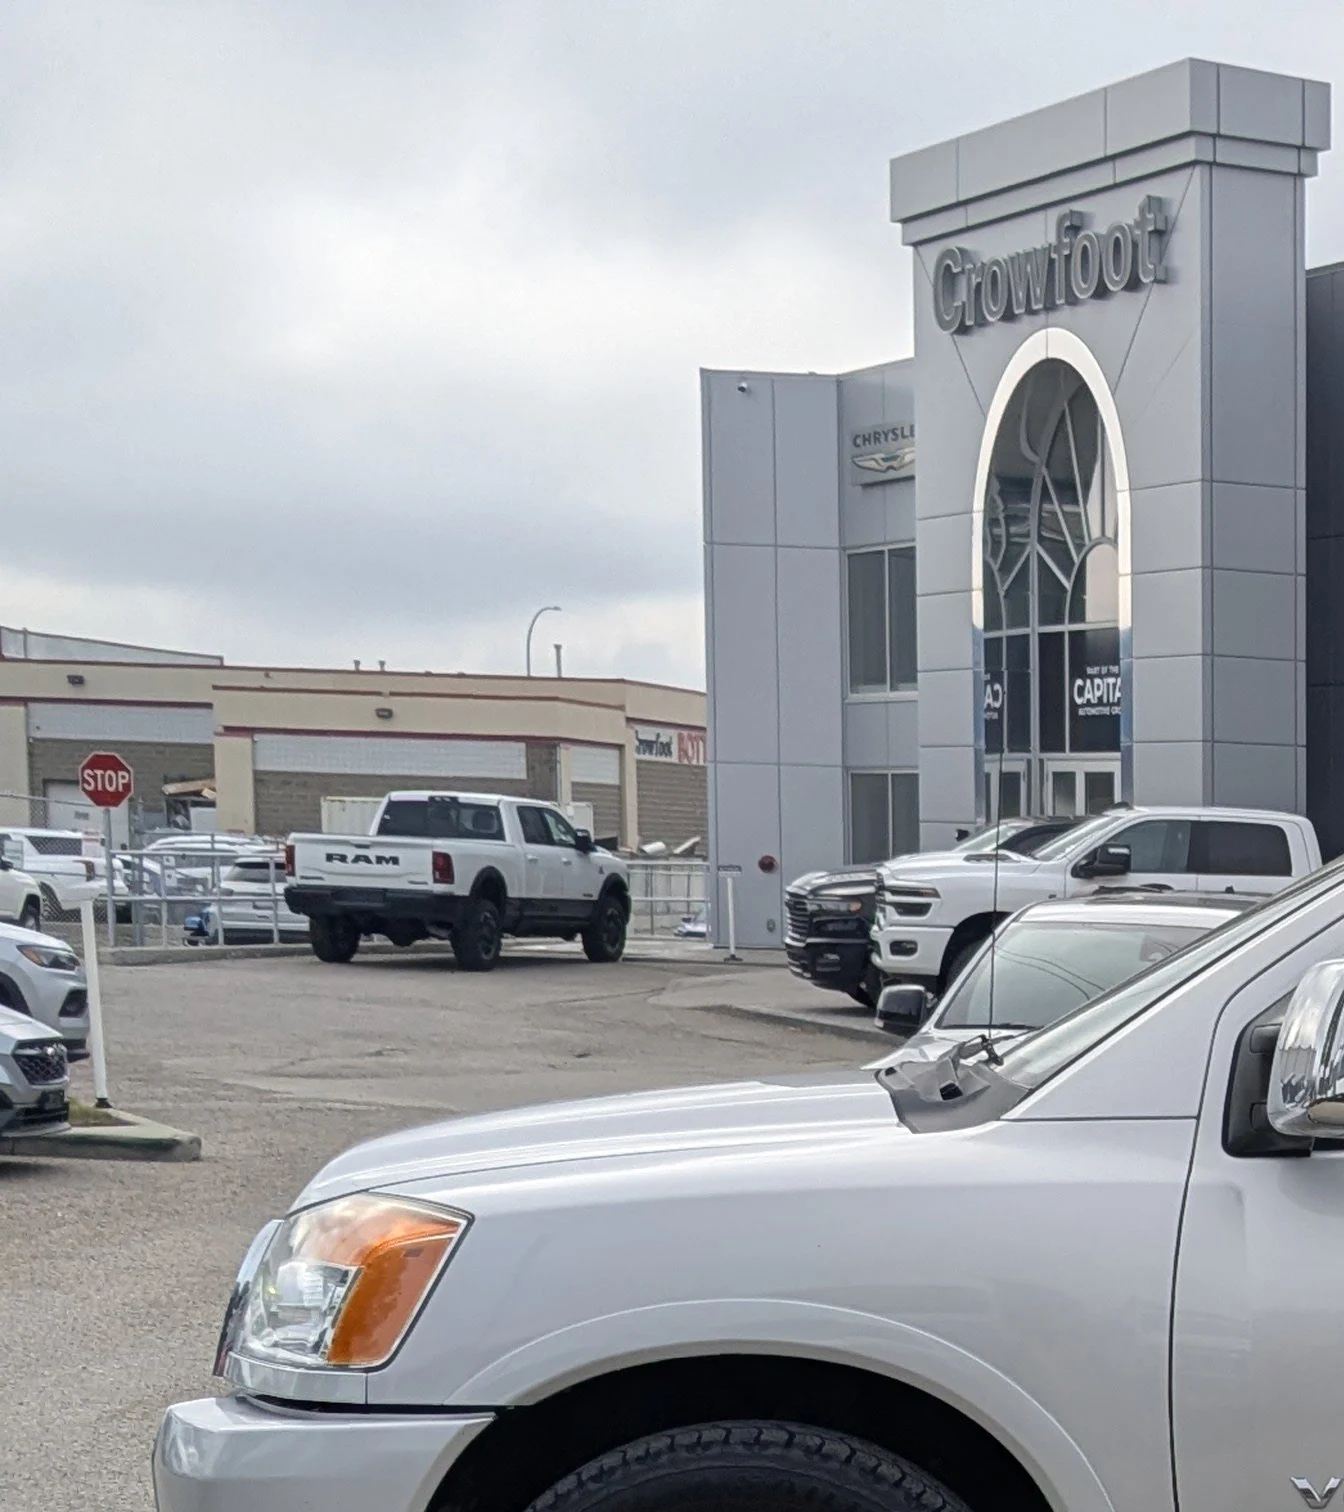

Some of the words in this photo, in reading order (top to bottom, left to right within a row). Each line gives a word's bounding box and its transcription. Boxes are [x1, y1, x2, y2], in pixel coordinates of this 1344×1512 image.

[933, 195, 1166, 334] Crowfoot
[83, 769, 130, 792] STOP
[325, 852, 400, 866] RAM
